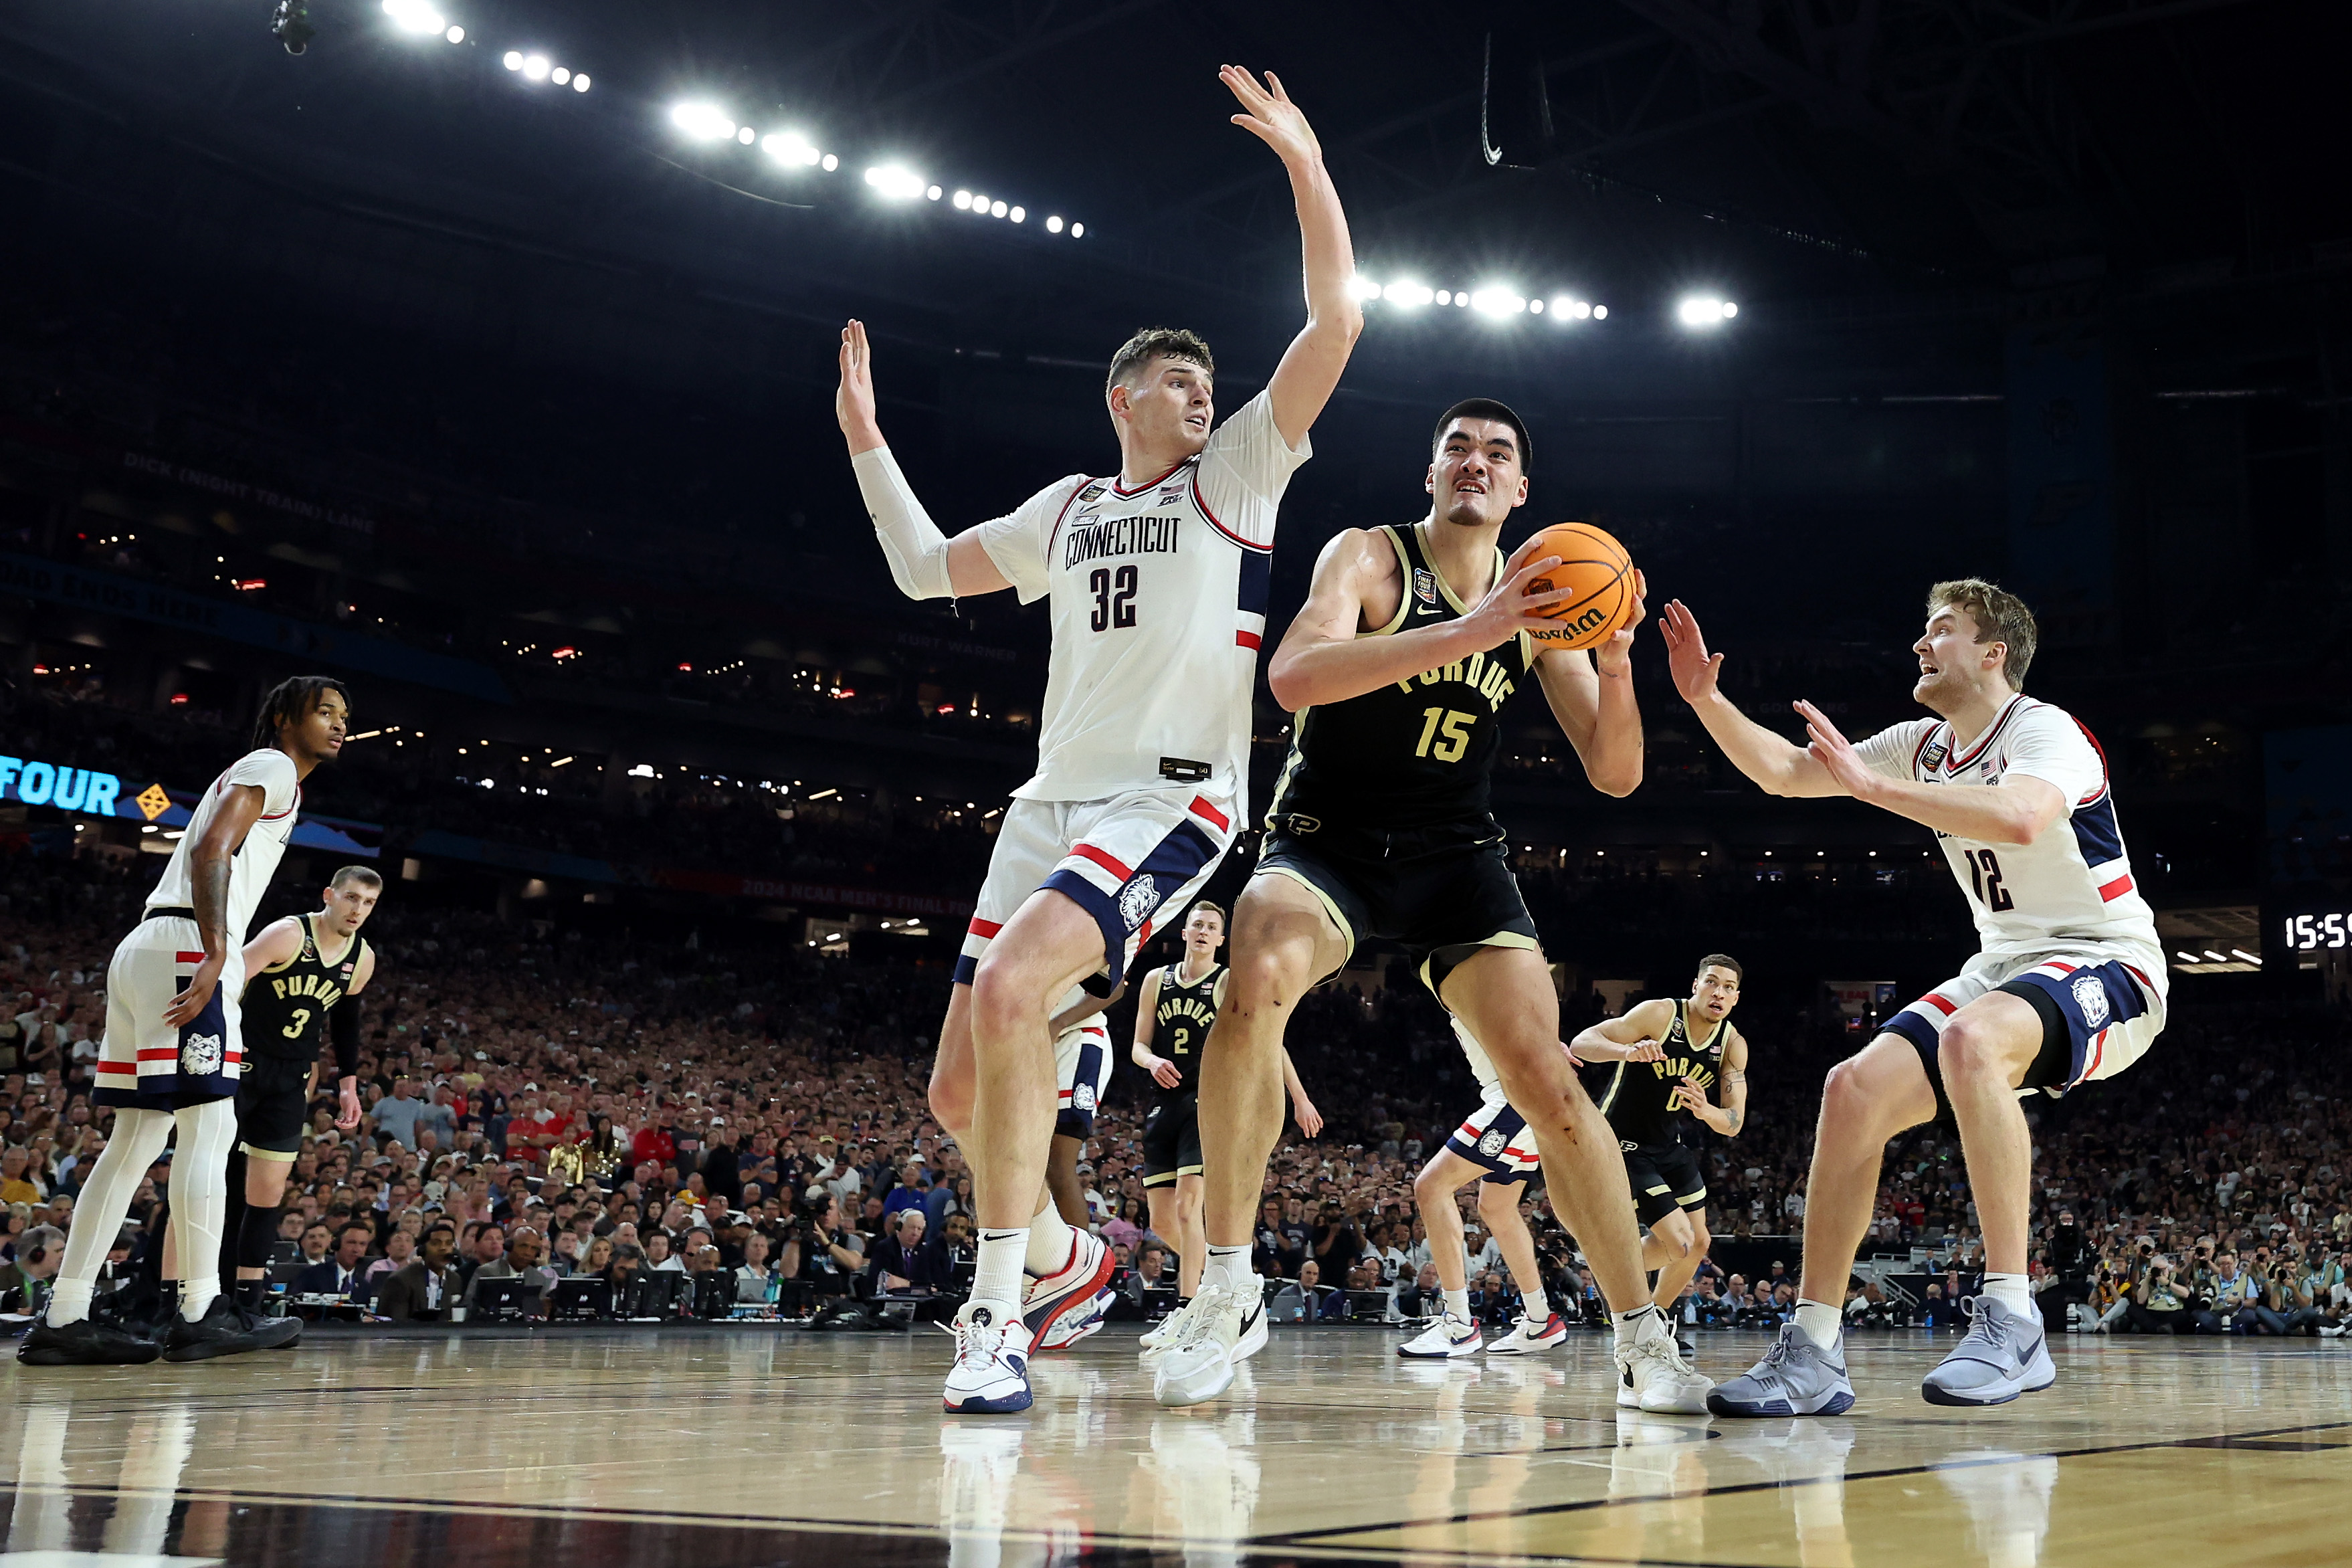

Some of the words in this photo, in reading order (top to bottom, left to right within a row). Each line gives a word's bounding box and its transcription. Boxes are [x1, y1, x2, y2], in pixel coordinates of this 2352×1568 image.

[124, 452, 171, 476] DICK
[179, 468, 249, 499] (NIGHT
[256, 488, 322, 520] TRAIN)
[327, 509, 375, 534] LANE
[1066, 516, 1181, 571] CONNECTICUT
[1090, 565, 1138, 632] 32
[1418, 581, 1431, 591] FOUR
[897, 631, 942, 649] KURT
[948, 641, 1017, 662] WARNER
[1415, 707, 1478, 763] 15
[0, 755, 120, 817] FOUR
[743, 879, 785, 898] 2024
[791, 884, 836, 902] NCAA
[840, 889, 892, 908] MEN'S
[898, 894, 944, 914] FINAL
[1964, 849, 2014, 912] 12
[2286, 912, 2352, 949] 15:5
[282, 1008, 310, 1039] 3
[1157, 997, 1215, 1027] PURDUE
[1175, 1027, 1189, 1054] 2
